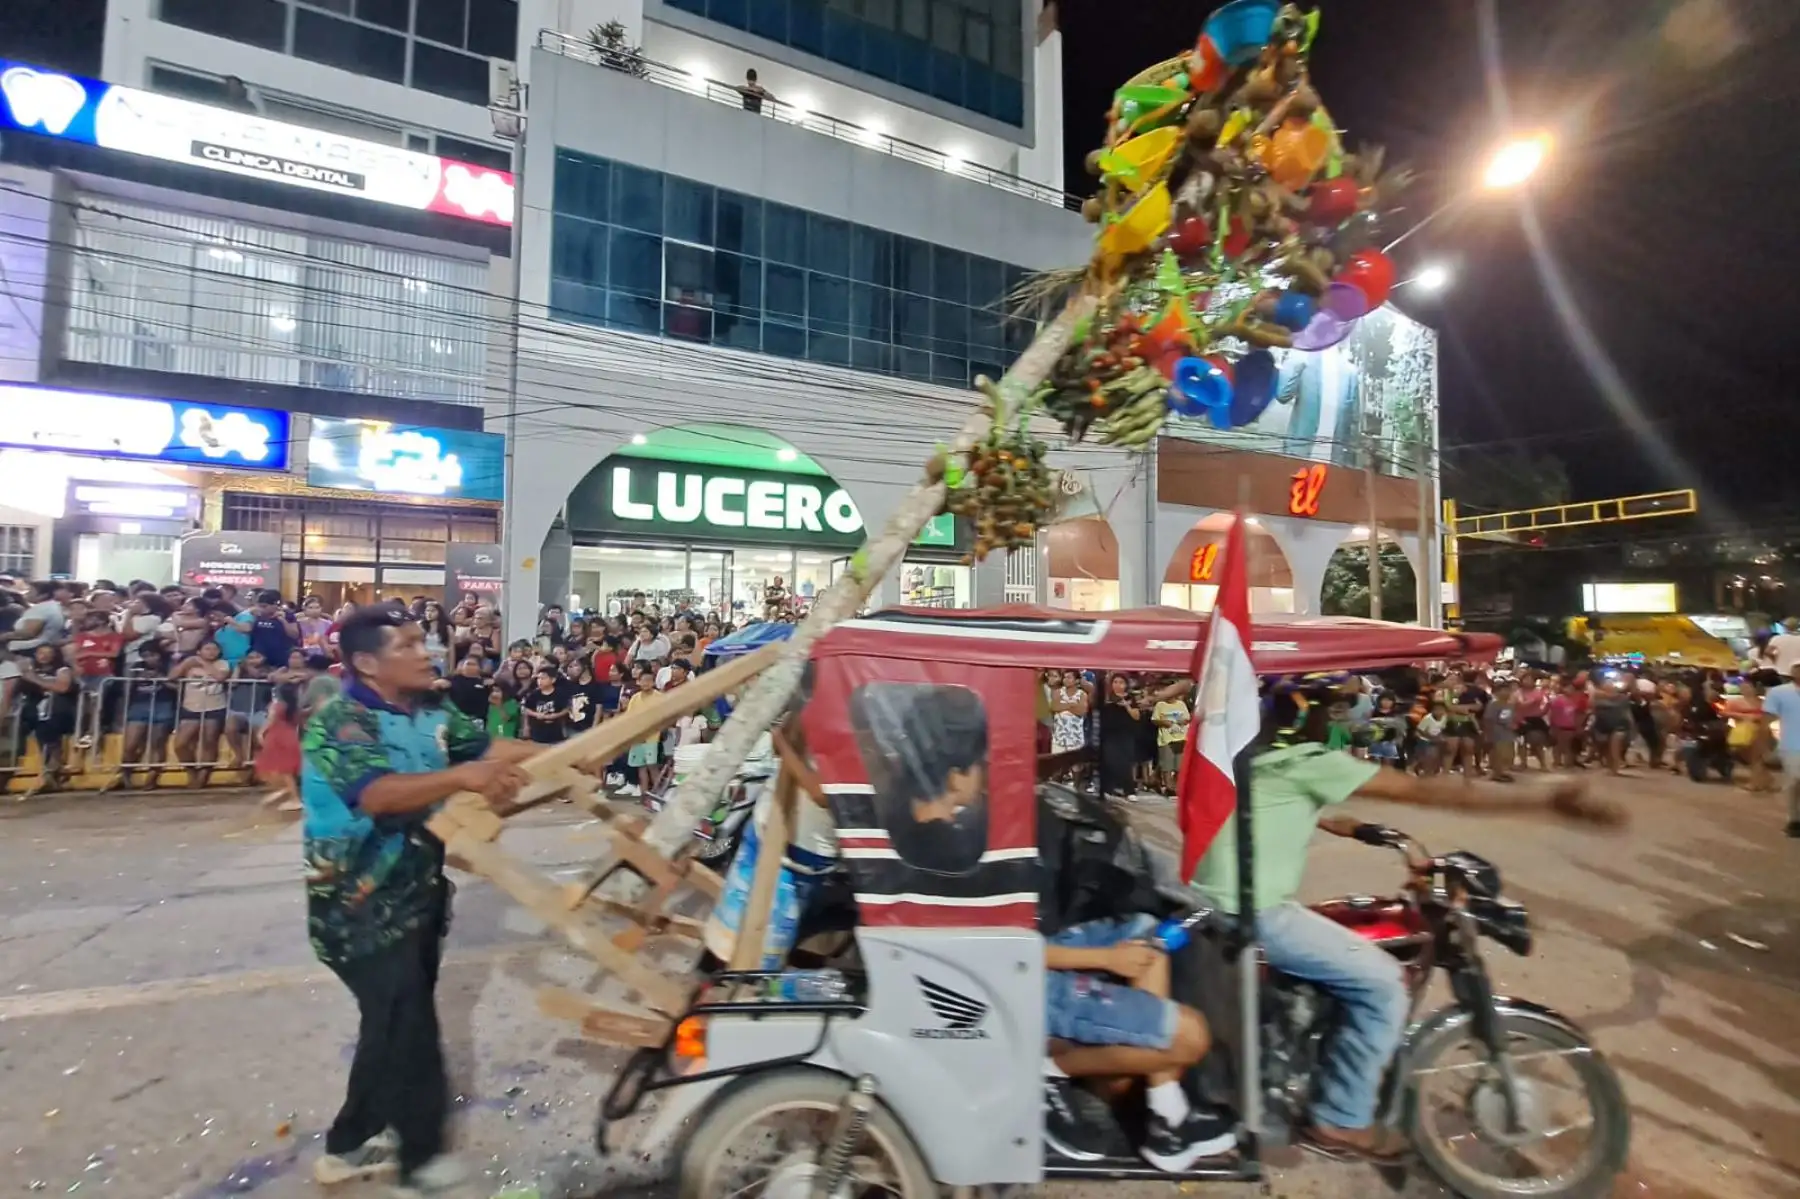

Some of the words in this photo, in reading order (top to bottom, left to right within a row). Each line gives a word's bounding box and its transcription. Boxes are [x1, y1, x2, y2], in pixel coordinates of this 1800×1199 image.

[202, 146, 283, 172] CLINICA
[283, 159, 355, 187] DENTAL
[612, 467, 864, 533] LUCERO
